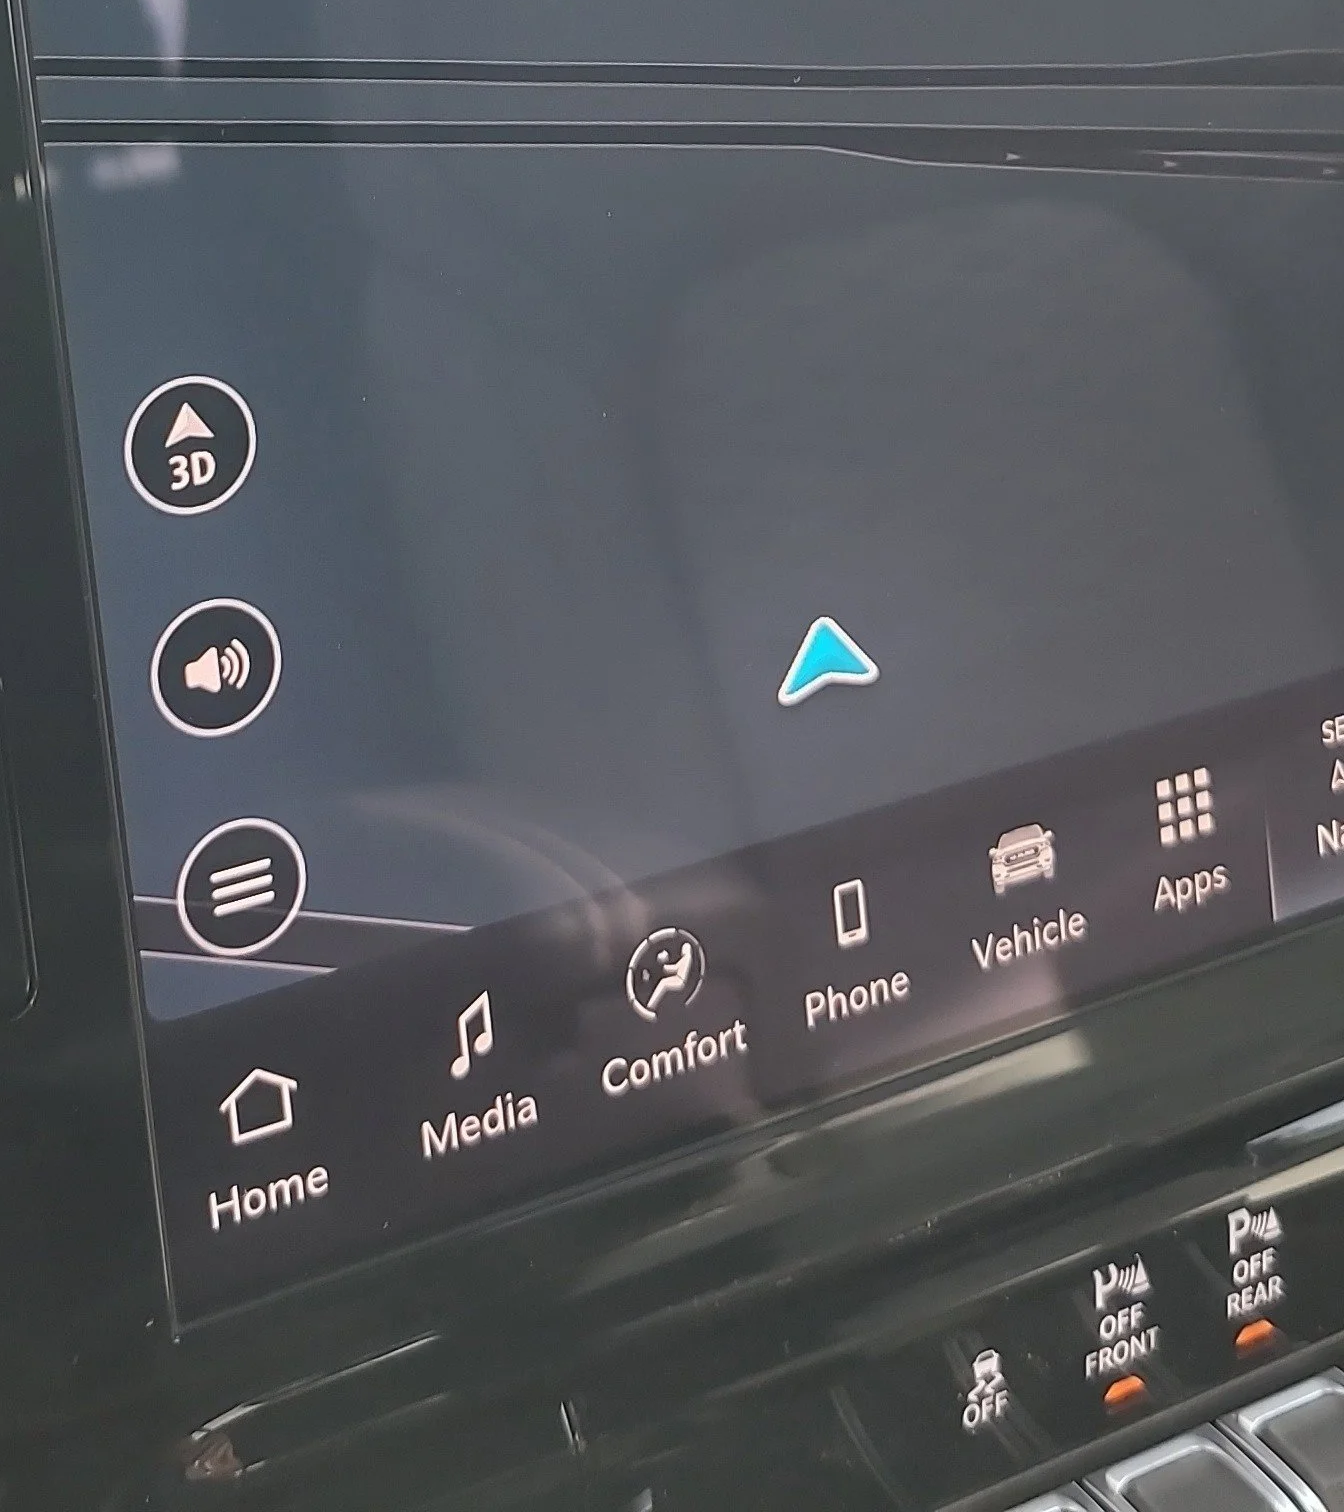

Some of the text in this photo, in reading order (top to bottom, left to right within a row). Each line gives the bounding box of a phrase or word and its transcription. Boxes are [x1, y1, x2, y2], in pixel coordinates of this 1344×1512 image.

[169, 449, 216, 491] 3D
[1154, 862, 1228, 913] Apps
[970, 908, 1088, 971] Vehicle
[804, 968, 910, 1029] Phone
[601, 1018, 748, 1097] Comfort
[420, 1092, 538, 1159] Media
[208, 1162, 329, 1231] Home
[1232, 1246, 1277, 1286] OFF
[1099, 1301, 1145, 1341] OFF
[1226, 1275, 1286, 1319] REAR
[1084, 1324, 1160, 1379] FRONT
[962, 1390, 1009, 1434] OFF
